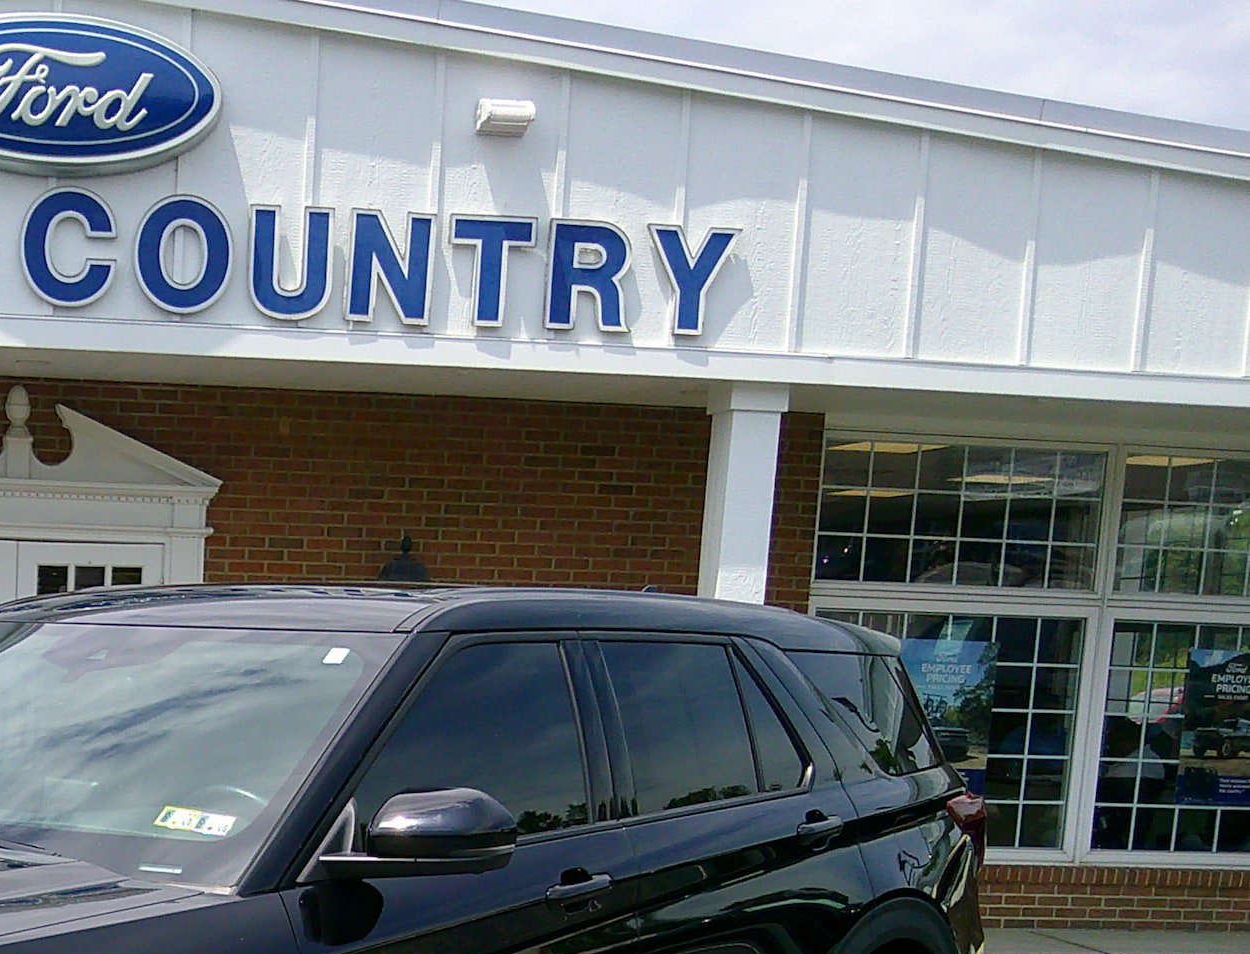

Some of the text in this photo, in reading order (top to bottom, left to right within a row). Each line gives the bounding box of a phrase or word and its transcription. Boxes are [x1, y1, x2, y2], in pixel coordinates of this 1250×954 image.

[21, 186, 743, 337] COUNTRY
[921, 662, 973, 674] EMPLOYEE
[925, 673, 966, 684] PRICING
